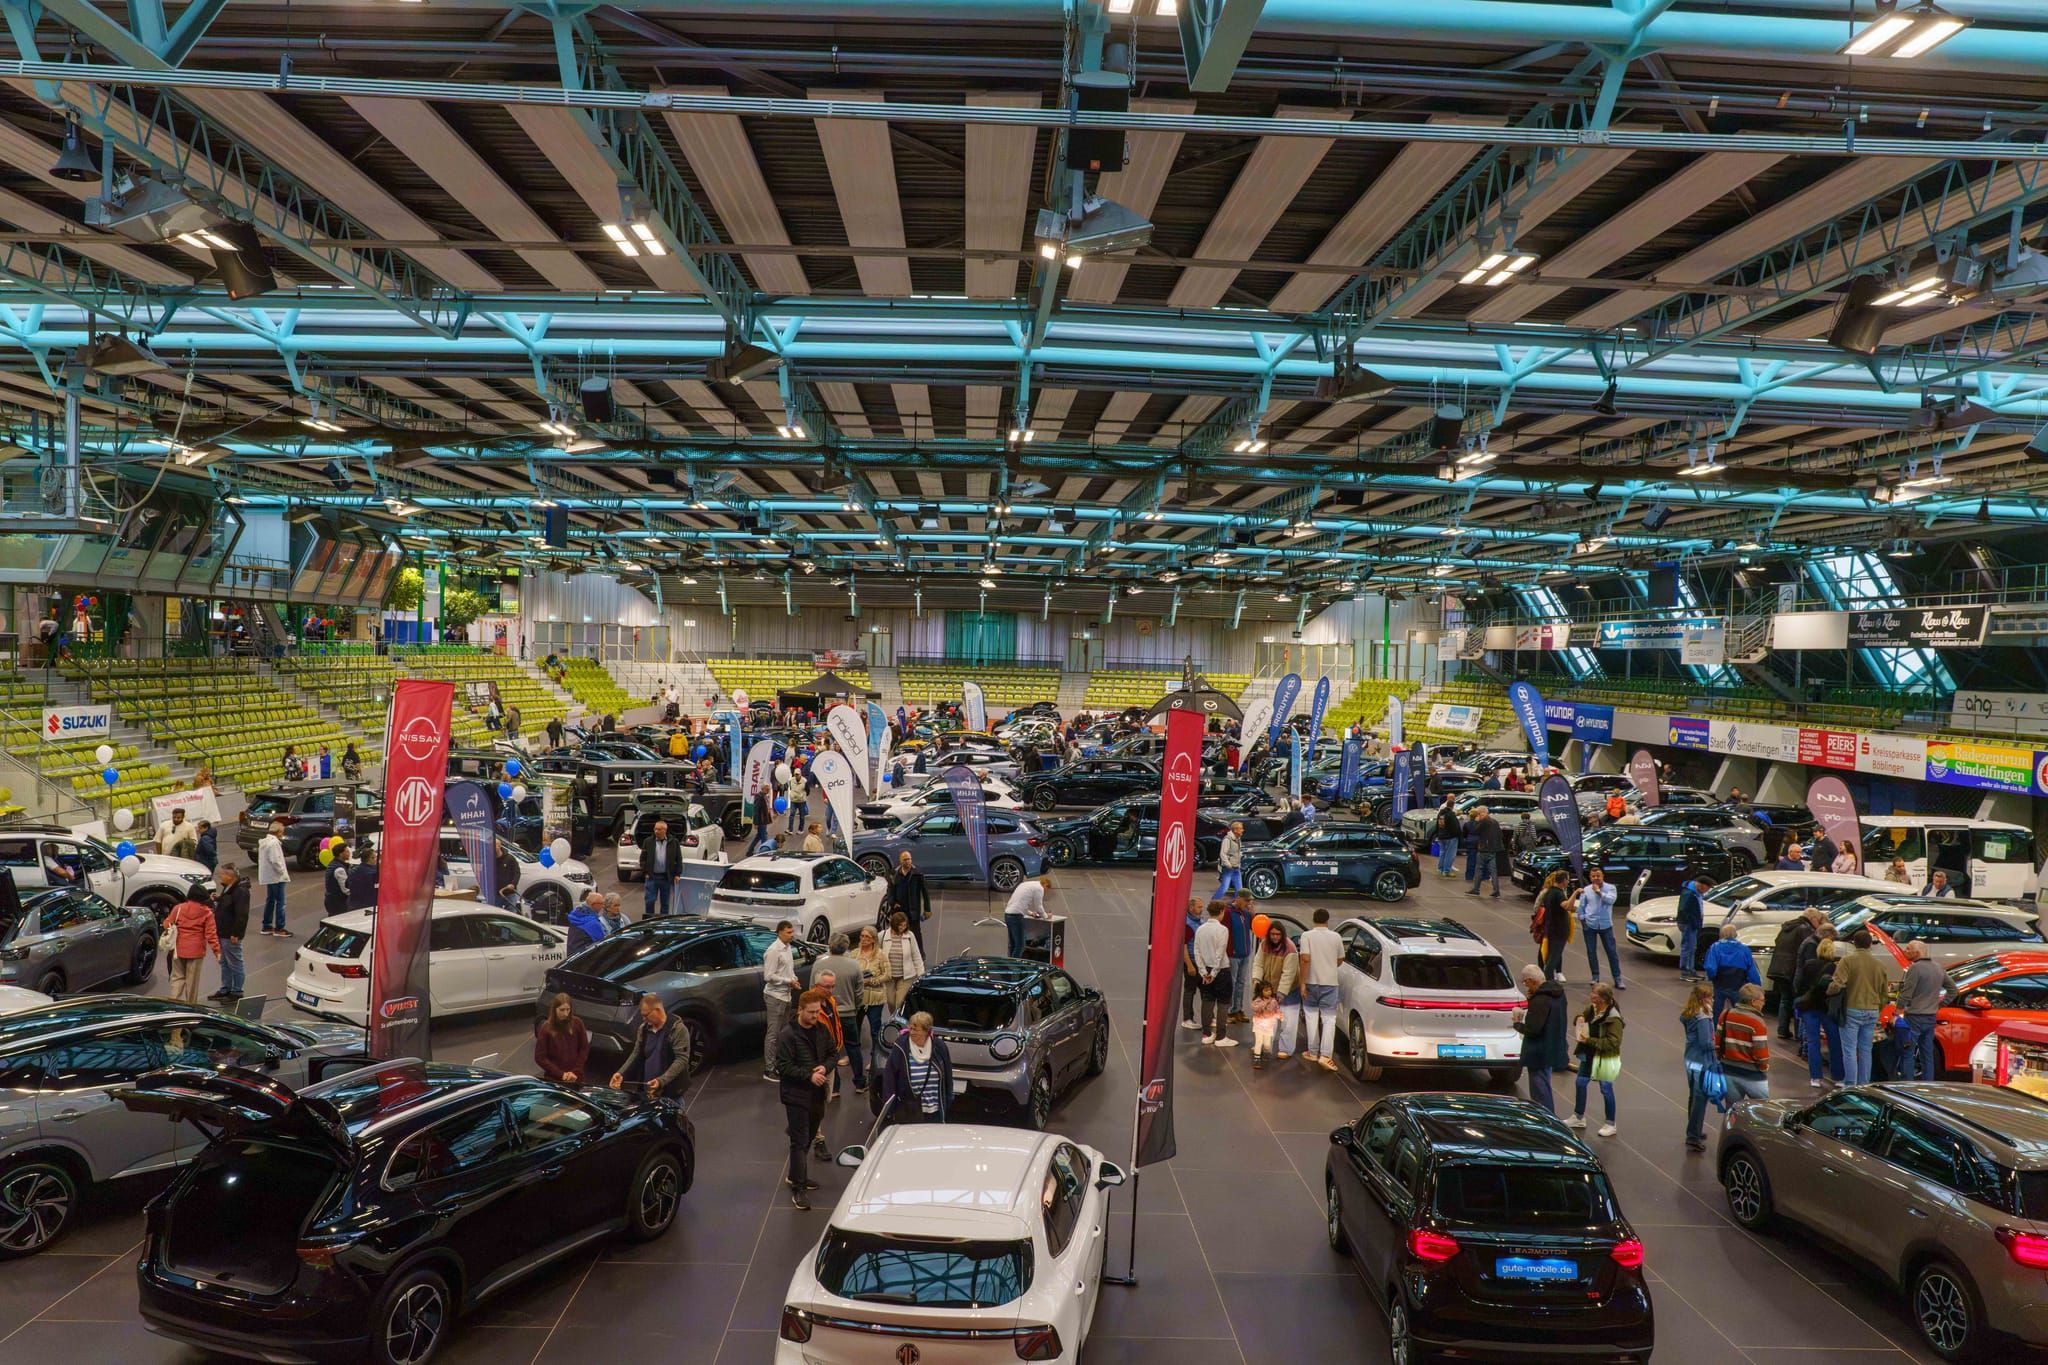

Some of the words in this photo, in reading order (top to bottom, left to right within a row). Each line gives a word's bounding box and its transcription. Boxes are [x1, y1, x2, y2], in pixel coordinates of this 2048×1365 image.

[1545, 704, 1574, 720] HYUNDAI
[1965, 695, 1993, 719] ahg
[62, 715, 107, 730] SUZUKI
[1523, 704, 1545, 747] HYUNDAI
[1585, 718, 1608, 730] HYUNDAI
[400, 734, 441, 744] NISSAN
[1827, 735, 1855, 752] PETERS
[1710, 738, 1727, 750] Stadt
[1736, 739, 1780, 757] Sindelfingen
[1873, 747, 1921, 762] Kreissparkasse
[1954, 747, 2029, 767] Badezentrum
[1872, 759, 1905, 774] Böblingen
[1954, 764, 2025, 784] Sindelfingen
[750, 759, 761, 796] BAW
[399, 780, 433, 823] MG
[1165, 826, 1185, 873] MG
[538, 952, 563, 963] HAHN
[1509, 1247, 1568, 1256] LEAPMOTOR
[1502, 1264, 1572, 1275] gute-mobile.de
